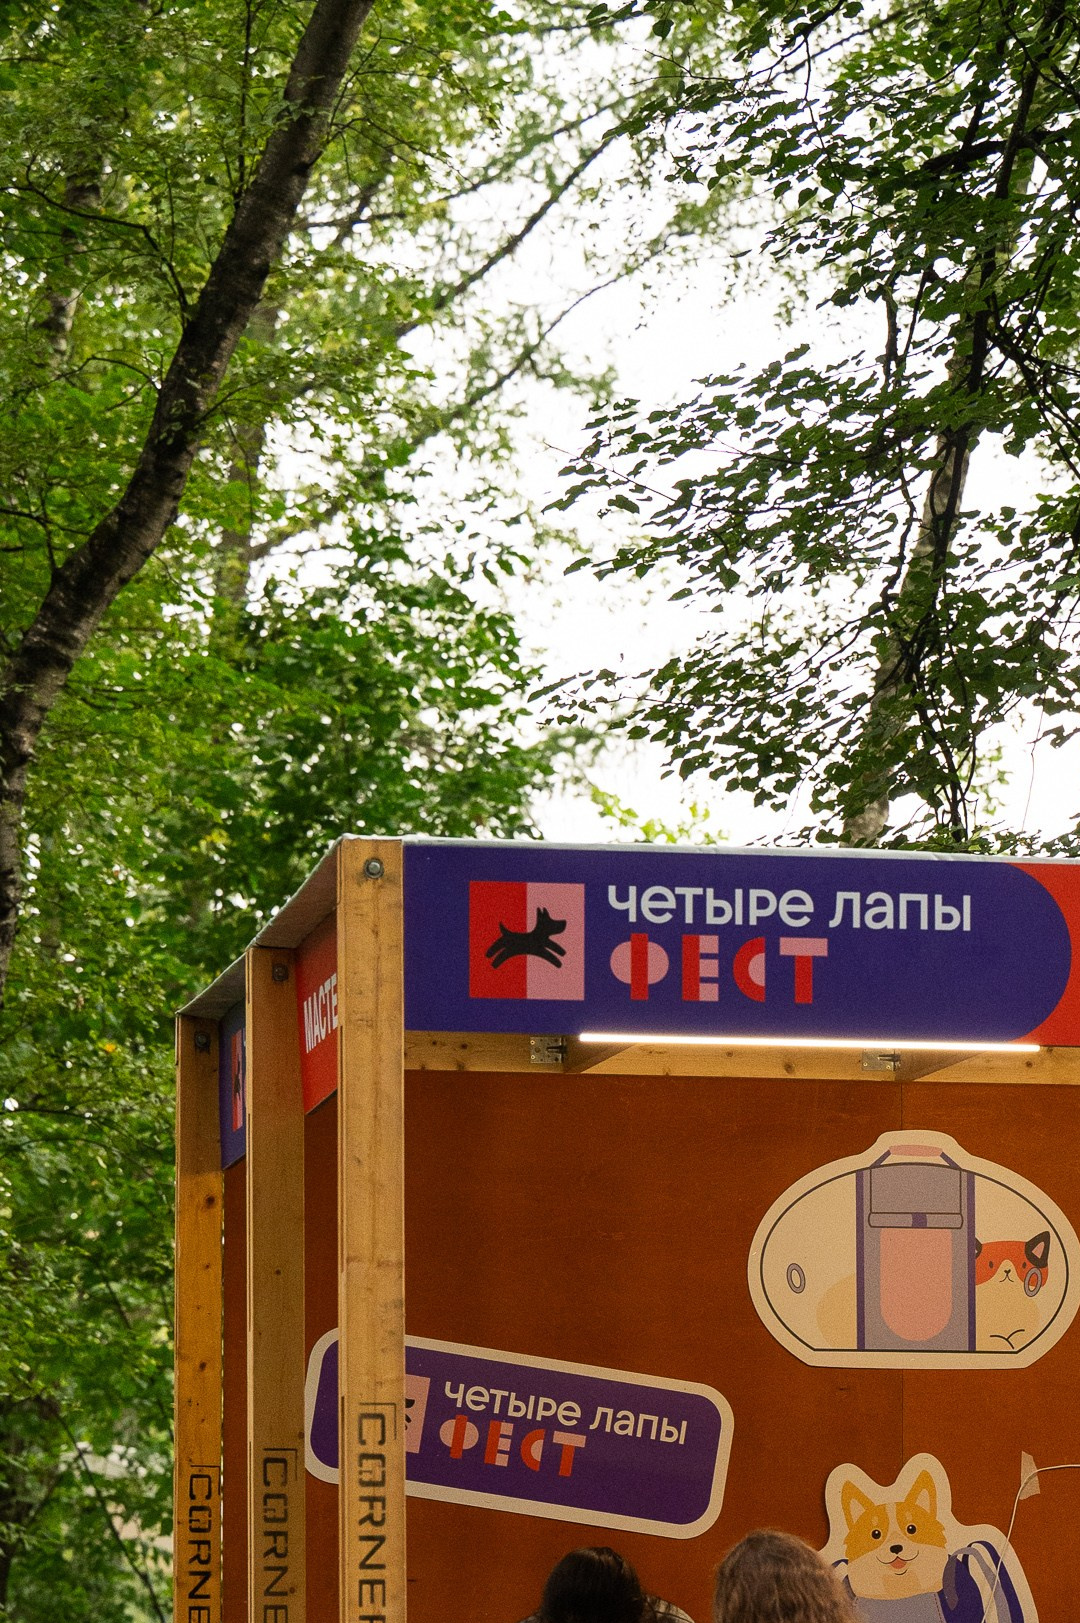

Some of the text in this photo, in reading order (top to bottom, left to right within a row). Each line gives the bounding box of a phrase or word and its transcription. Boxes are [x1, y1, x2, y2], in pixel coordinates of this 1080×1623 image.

[607, 885, 972, 931] четыре лапы
[609, 932, 829, 1005] ФЕСТ
[303, 973, 338, 1053] МАСТЕ
[444, 1381, 688, 1445] четыре лапы
[439, 1414, 587, 1477] ФЕСТ
